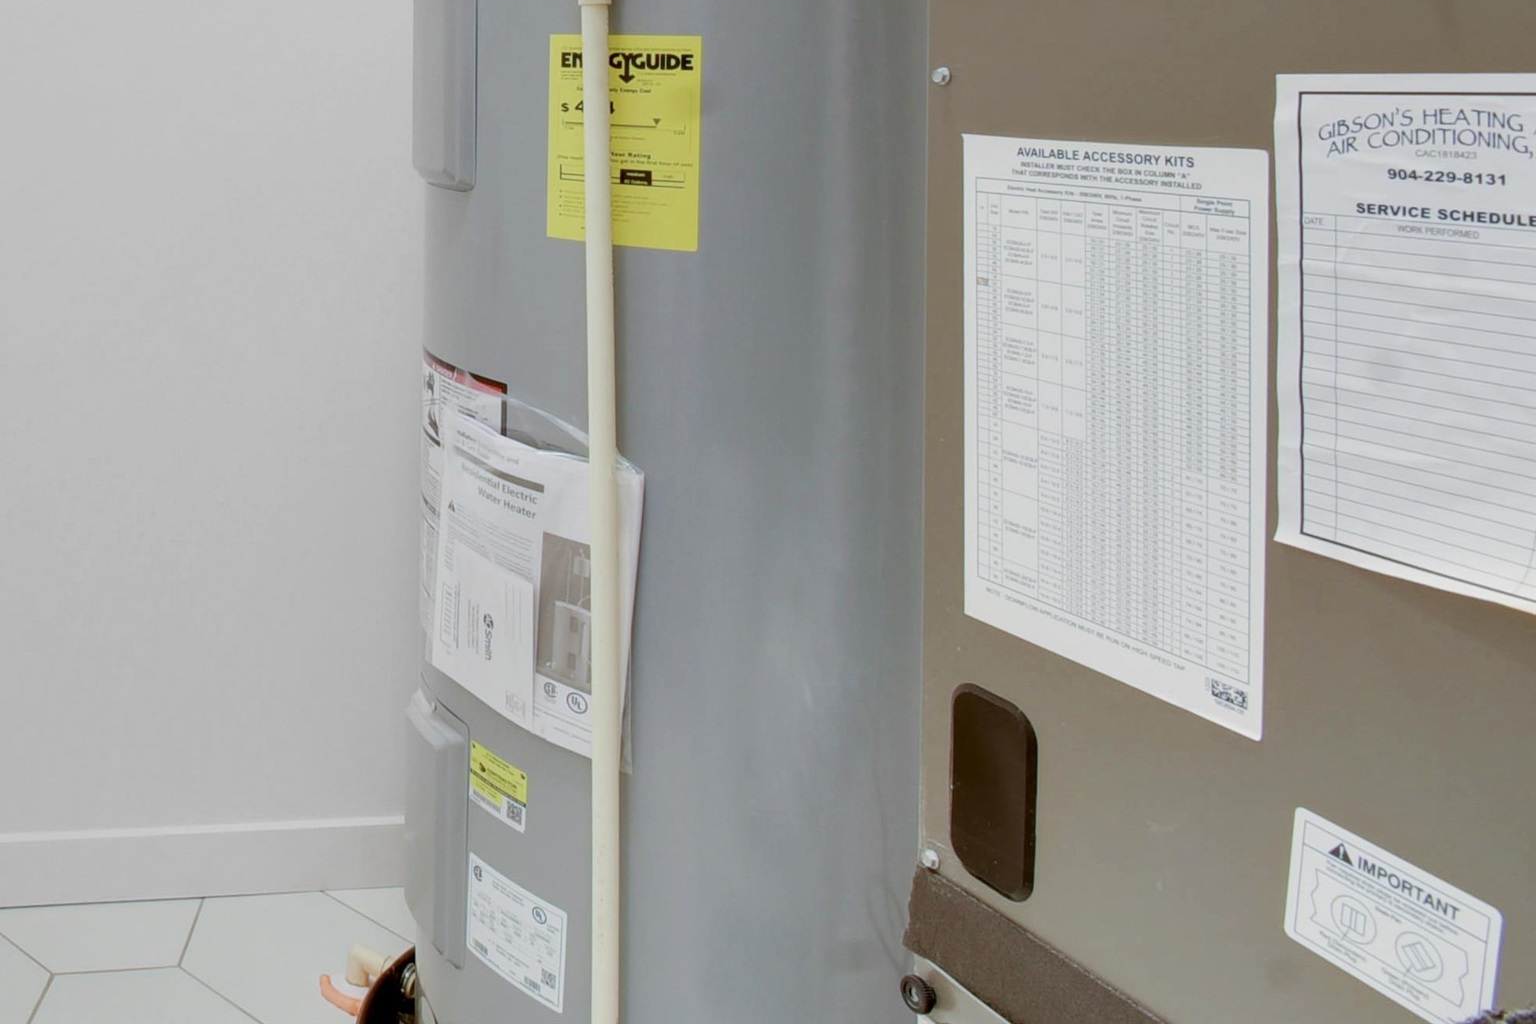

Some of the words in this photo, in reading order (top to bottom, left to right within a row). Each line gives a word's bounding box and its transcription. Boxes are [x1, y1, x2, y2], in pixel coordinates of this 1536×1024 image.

[561, 51, 694, 76] ENGYGUIDE
[1318, 108, 1413, 141] GIBSON'S
[1423, 108, 1524, 133] HEATING
[1326, 136, 1359, 158] AIR
[1367, 128, 1534, 159] CONDITIONING,
[1415, 149, 1477, 160] CAC1818423
[1017, 147, 1079, 161] AVAILABLE
[1083, 151, 1161, 166] ACCESSORY
[1165, 155, 1195, 168] KITS
[1020, 161, 1055, 170] INSTALLER
[1057, 163, 1075, 171] MUST
[1077, 164, 1100, 173] CHECK
[1118, 167, 1132, 175] BOX
[1144, 169, 1174, 178] COLUMN
[1029, 170, 1079, 180] CORRESPONDS
[1099, 175, 1112, 183] THE
[1114, 176, 1158, 186] ACCESSORY
[1161, 179, 1202, 189] INSTALLED
[1387, 168, 1506, 186] 904-229-8131
[1304, 216, 1324, 225] DATE
[1356, 202, 1431, 219] SERVICE
[1437, 208, 1536, 227] SCHEDULE
[1397, 225, 1423, 233] WORK
[1424, 226, 1480, 240] PERFORMED
[477, 487, 501, 506] Water
[503, 499, 536, 520] Heater
[502, 479, 538, 506] Electric
[1357, 856, 1460, 921] IMPORTANT
